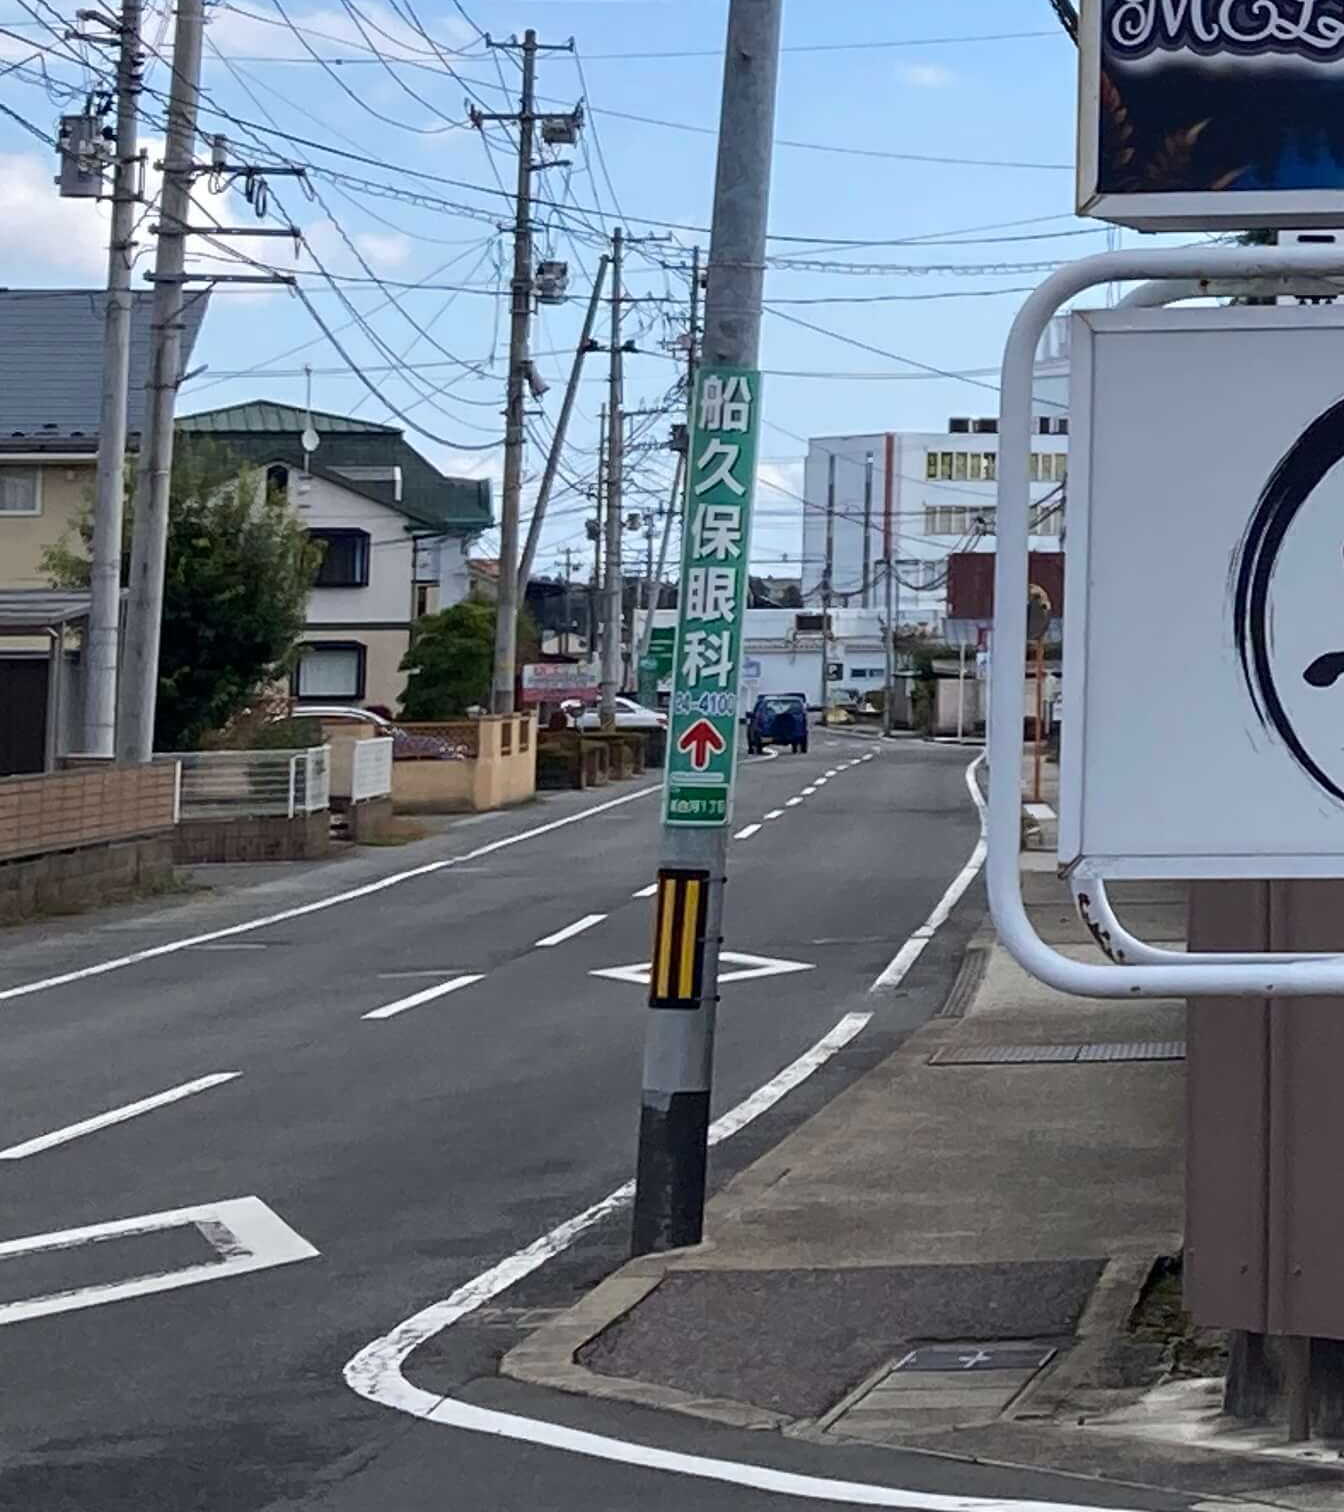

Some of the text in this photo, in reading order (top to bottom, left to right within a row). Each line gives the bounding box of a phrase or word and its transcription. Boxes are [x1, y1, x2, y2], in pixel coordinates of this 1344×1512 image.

[683, 374, 752, 688] 船久保眼科
